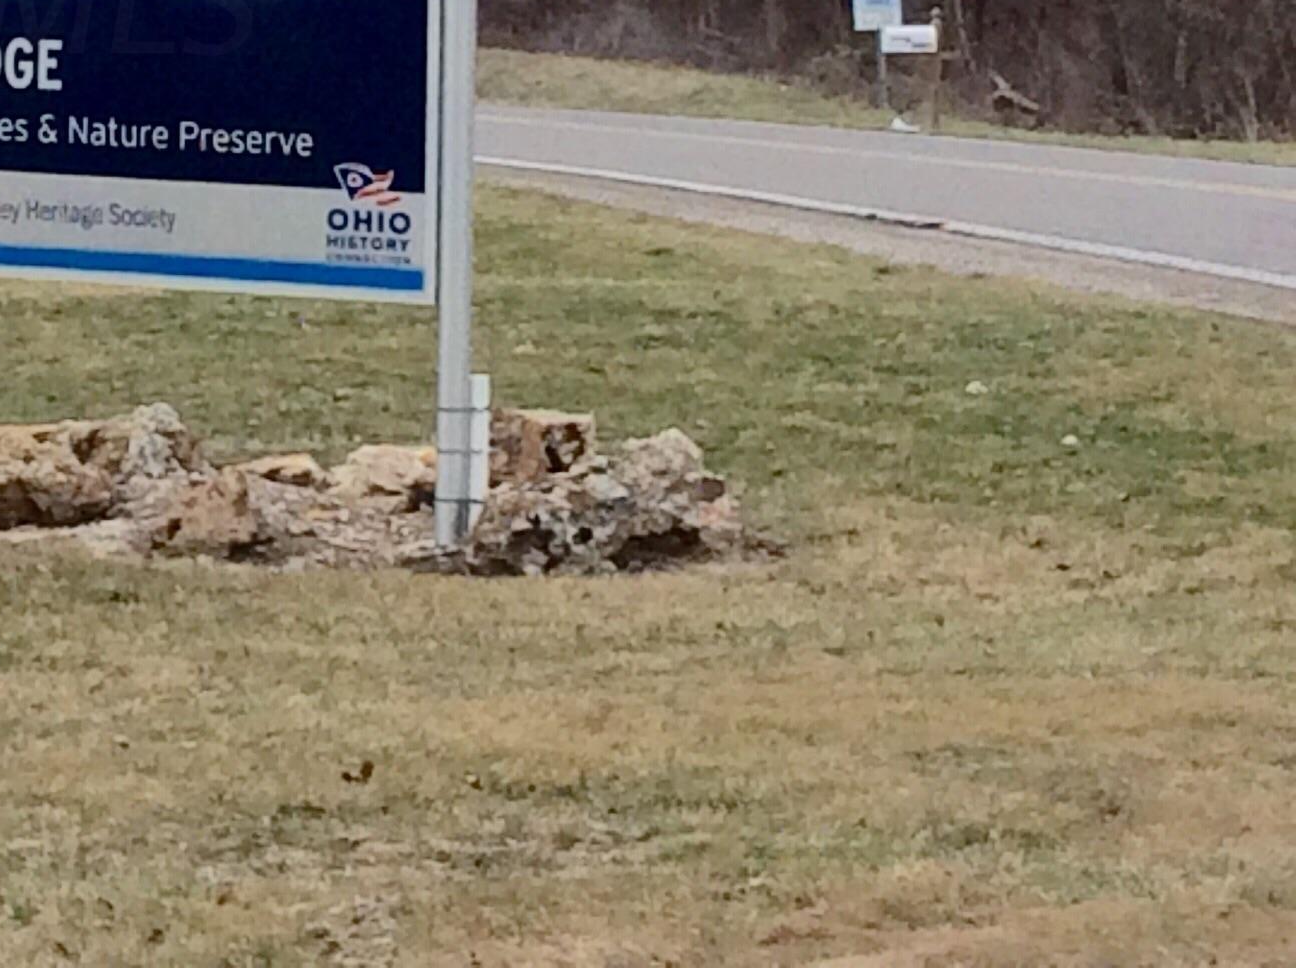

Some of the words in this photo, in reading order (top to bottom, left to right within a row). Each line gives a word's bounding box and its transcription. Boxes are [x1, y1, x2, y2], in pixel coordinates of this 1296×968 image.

[37, 114, 58, 144] &
[68, 115, 169, 150] Nature
[179, 121, 314, 158] Preserve
[26, 200, 104, 230] Heritage
[108, 203, 176, 234] Society
[327, 208, 411, 234] OHIO
[326, 233, 410, 253] HISTORY
